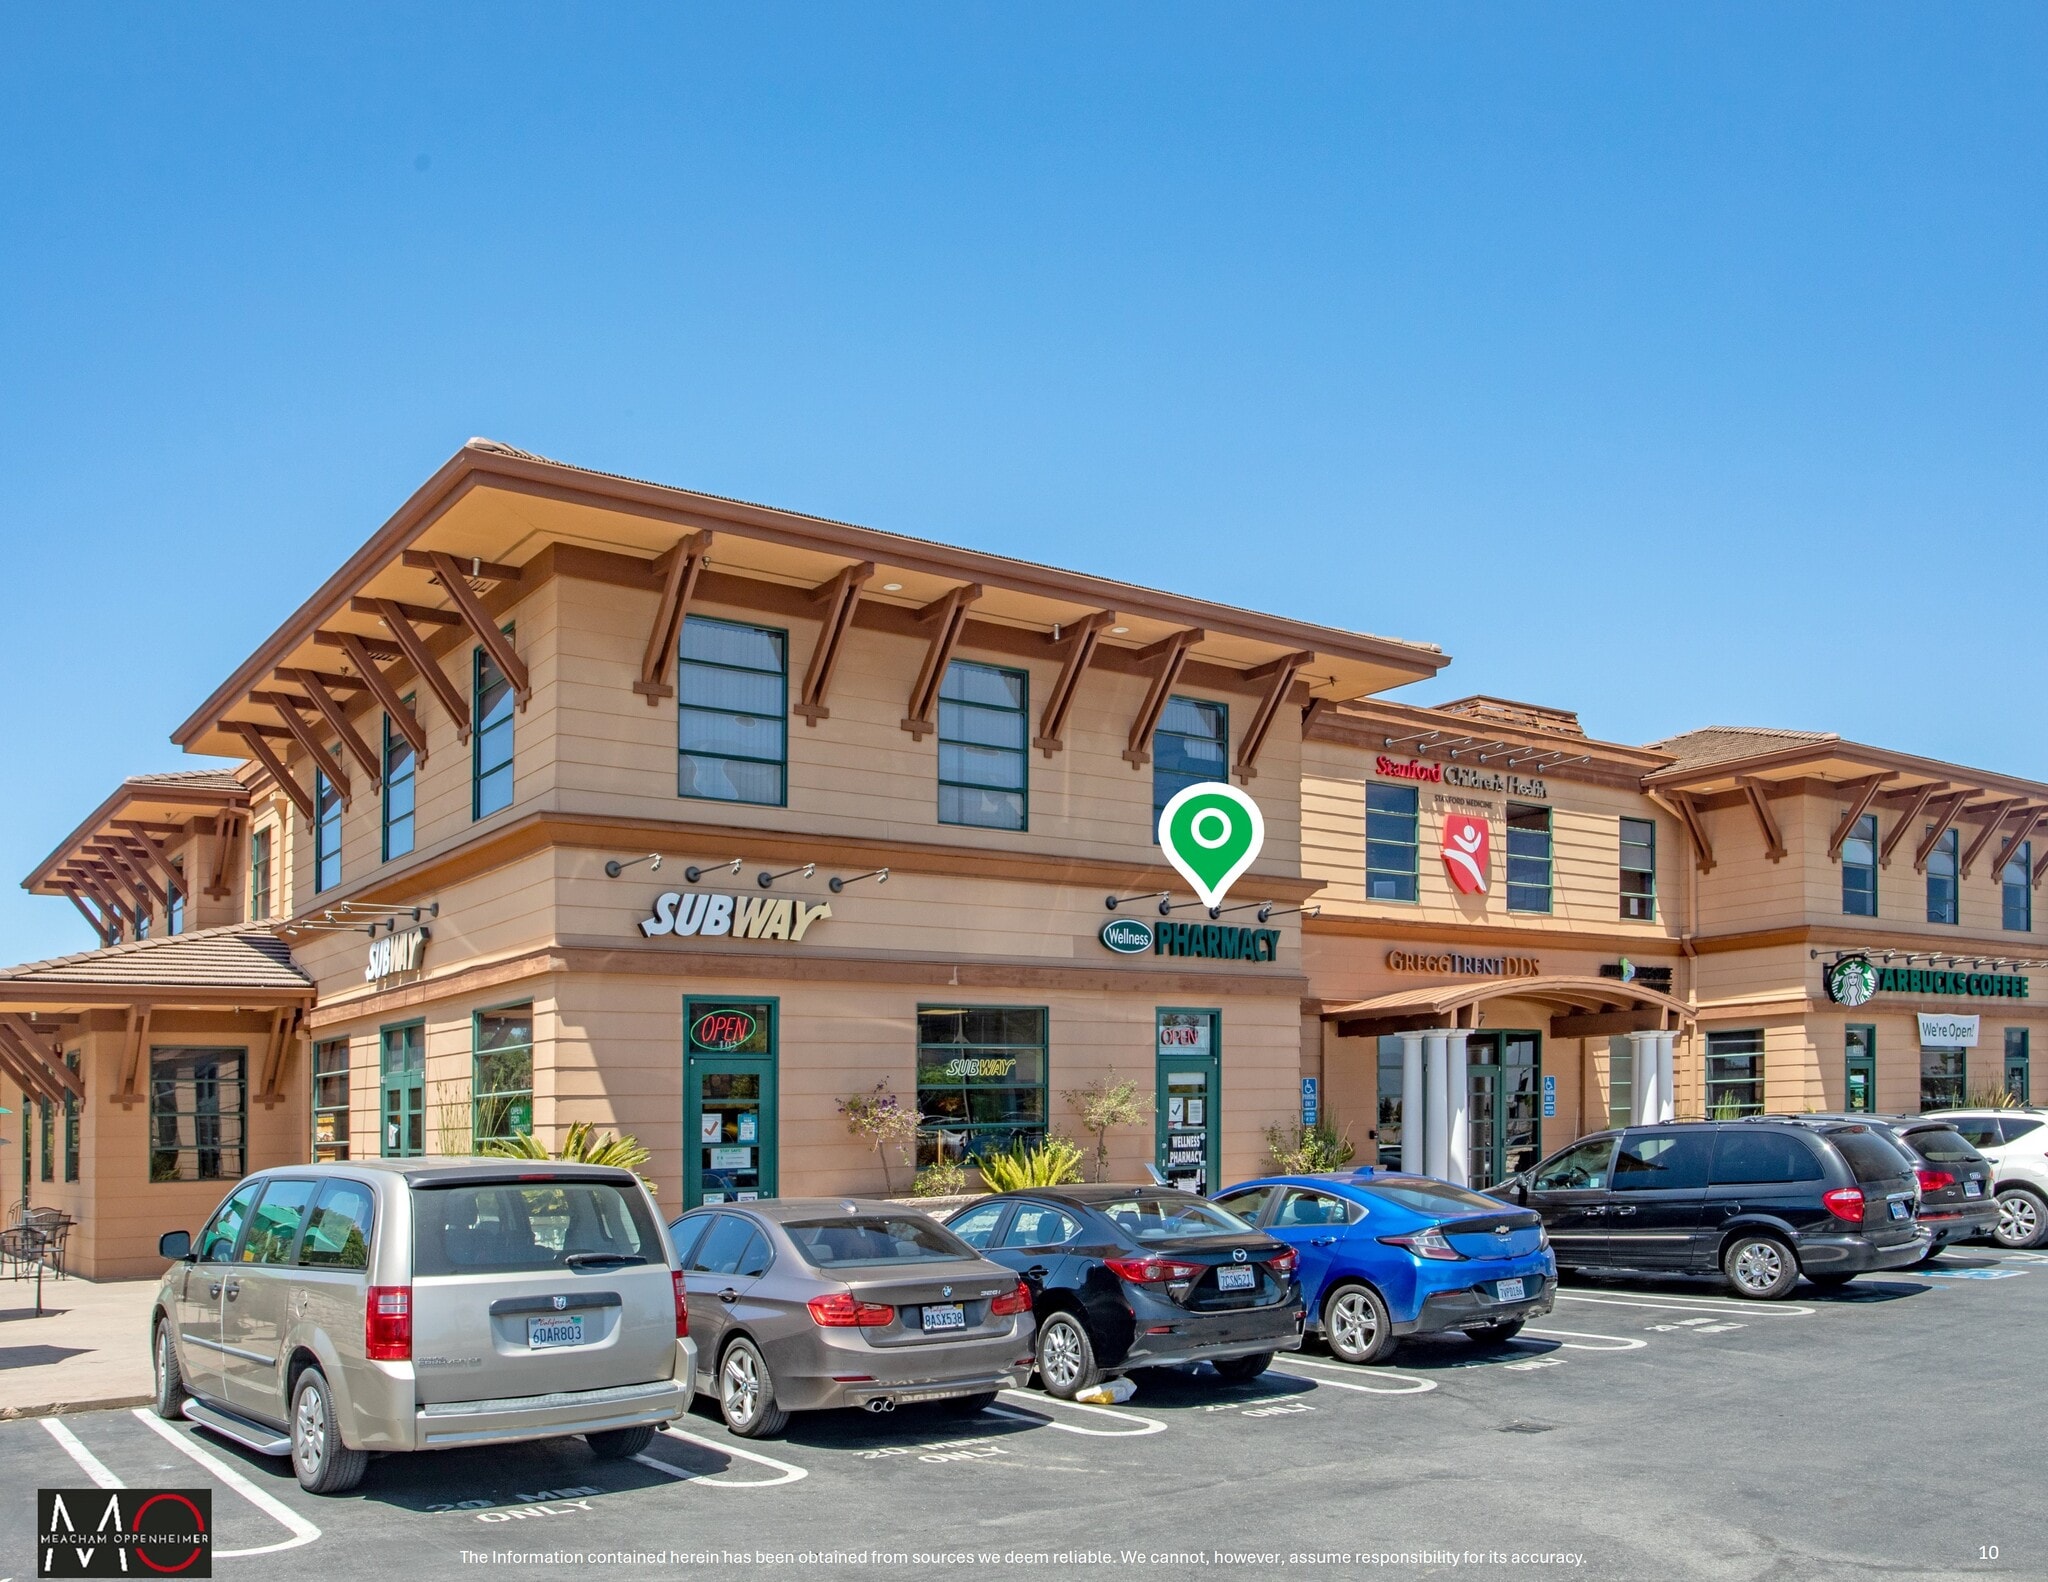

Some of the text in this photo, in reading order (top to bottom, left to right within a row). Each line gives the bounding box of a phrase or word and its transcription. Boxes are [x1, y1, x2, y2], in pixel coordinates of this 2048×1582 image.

[1376, 755, 1547, 799] Stanford Children's Health
[1434, 795, 1493, 809] STANFORD MEDICINE
[638, 891, 833, 941] SUBWAY
[1108, 921, 1281, 962] Wellness PHARMACY
[365, 927, 430, 983] SUBWAY
[1969, 973, 2029, 998] COFFEE
[701, 1015, 748, 1042] OPEN
[1161, 1029, 1199, 1046] OPEN
[1922, 1022, 1976, 1041] We're Open!
[946, 1058, 1017, 1077] SUBWAY
[1172, 1135, 1201, 1149] WELLNESS
[1169, 1150, 1203, 1165] PHARMACY
[540, 1317, 571, 1327] California
[925, 1311, 963, 1327] 8ASX538
[532, 1325, 582, 1344] 6DAR803
[1241, 1402, 1316, 1417] ONLY
[918, 1446, 1009, 1463] ONLY
[426, 1499, 496, 1514] 20
[476, 1500, 593, 1523] ONLY
